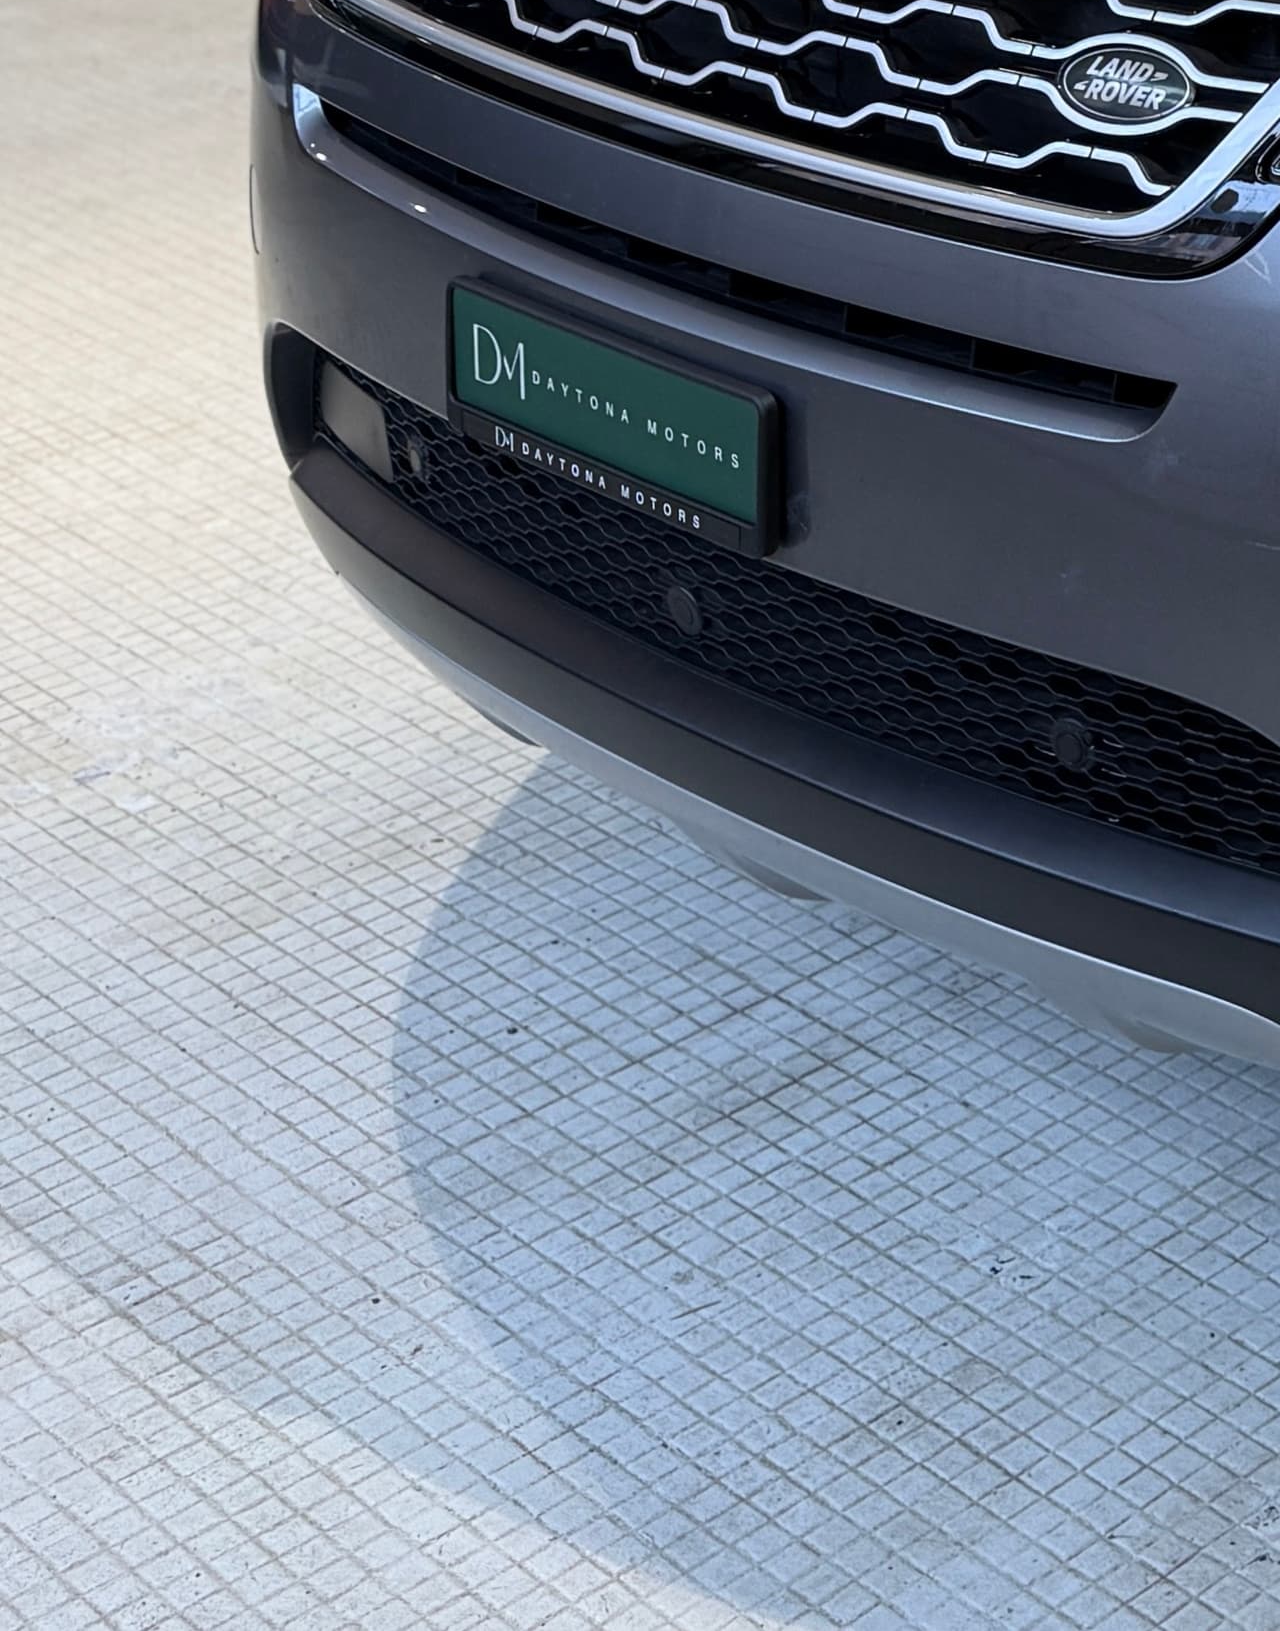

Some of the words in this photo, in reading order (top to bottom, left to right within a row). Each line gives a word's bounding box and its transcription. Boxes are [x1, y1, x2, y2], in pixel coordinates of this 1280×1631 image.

[1084, 78, 1167, 110] ROVER
[473, 324, 525, 400] DM
[532, 370, 629, 424] DAYTONA
[647, 419, 740, 469] MOTORS
[522, 442, 606, 490] DAYTONA
[621, 484, 701, 529] MOTORS
